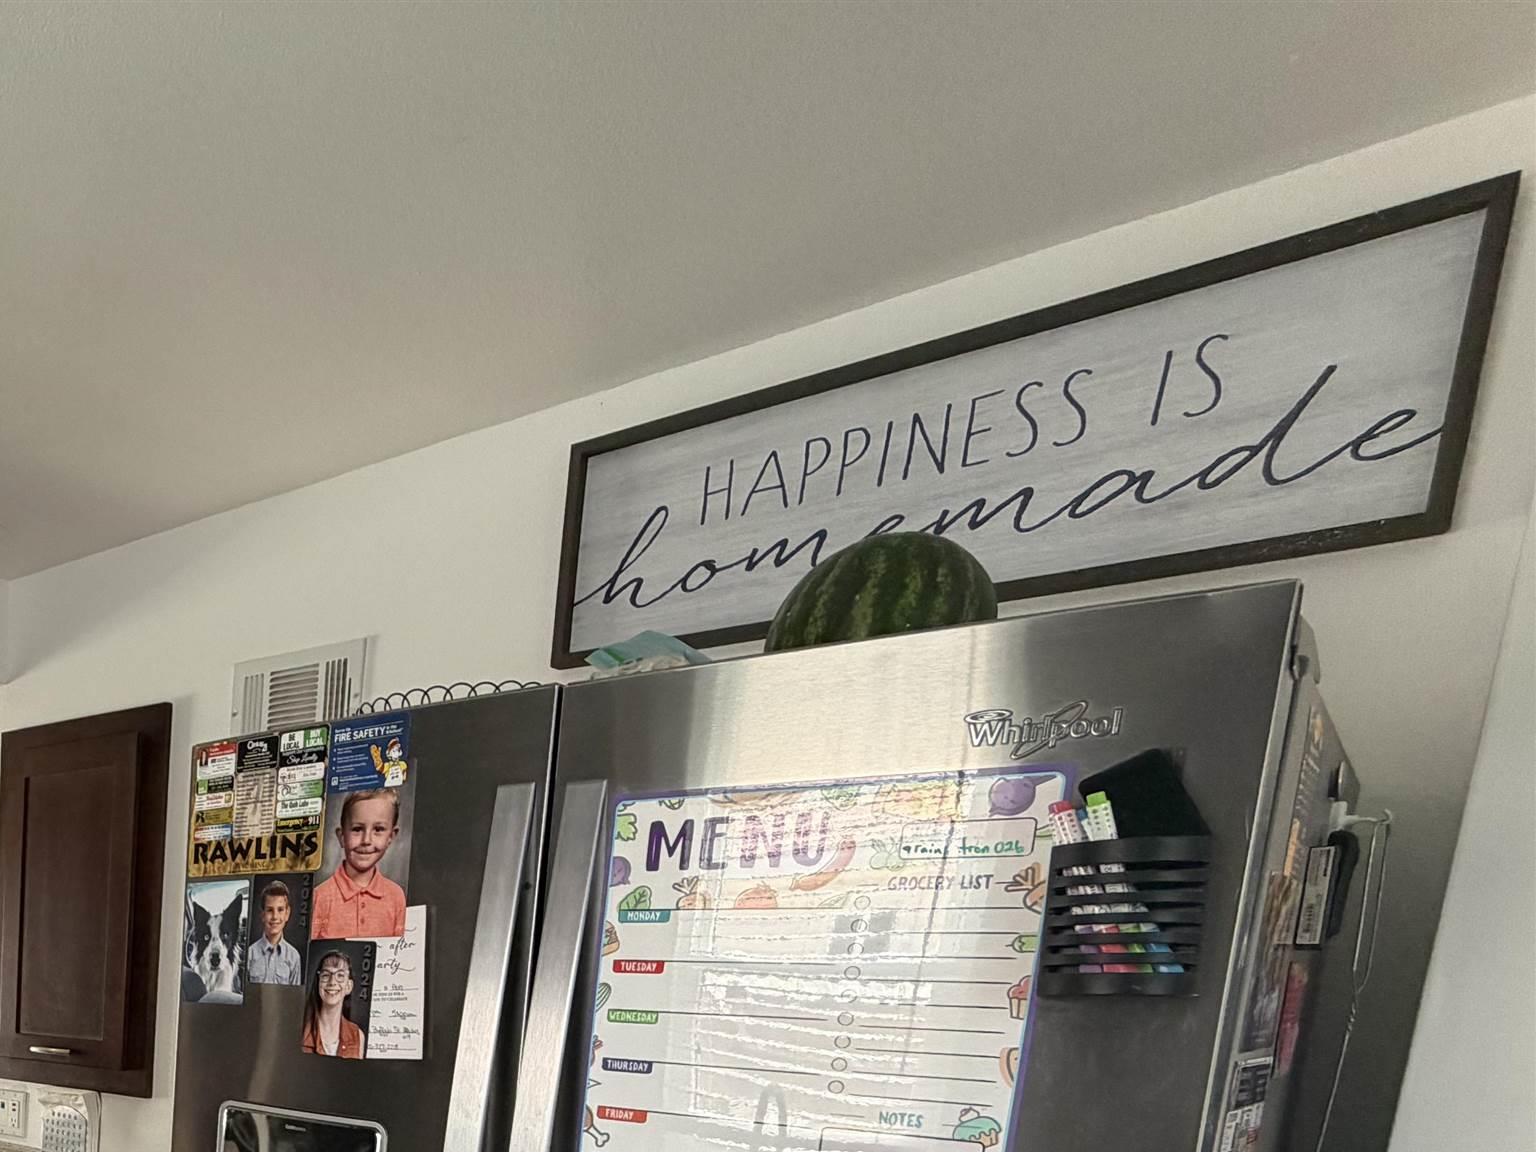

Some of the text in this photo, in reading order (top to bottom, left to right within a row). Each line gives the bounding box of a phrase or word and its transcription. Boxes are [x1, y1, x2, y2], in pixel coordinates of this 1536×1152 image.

[698, 333, 1230, 527] HAPPINESS IS
[334, 731, 352, 743] FIRE
[352, 726, 386, 740] SAFETY
[967, 706, 1123, 750] Whirlpool
[308, 815, 320, 825] 911
[193, 832, 318, 864] RAWLINS
[646, 811, 831, 872] MENU
[887, 874, 995, 891] GROCERY LIST
[627, 910, 661, 922] MONDAY
[389, 936, 416, 956] after
[620, 961, 657, 972] TUESDAY
[609, 1011, 658, 1022] WEDNESDAY
[607, 1060, 649, 1072] THURSDAY
[605, 1109, 634, 1121] FRIDAY
[878, 1110, 923, 1128] NOTES
